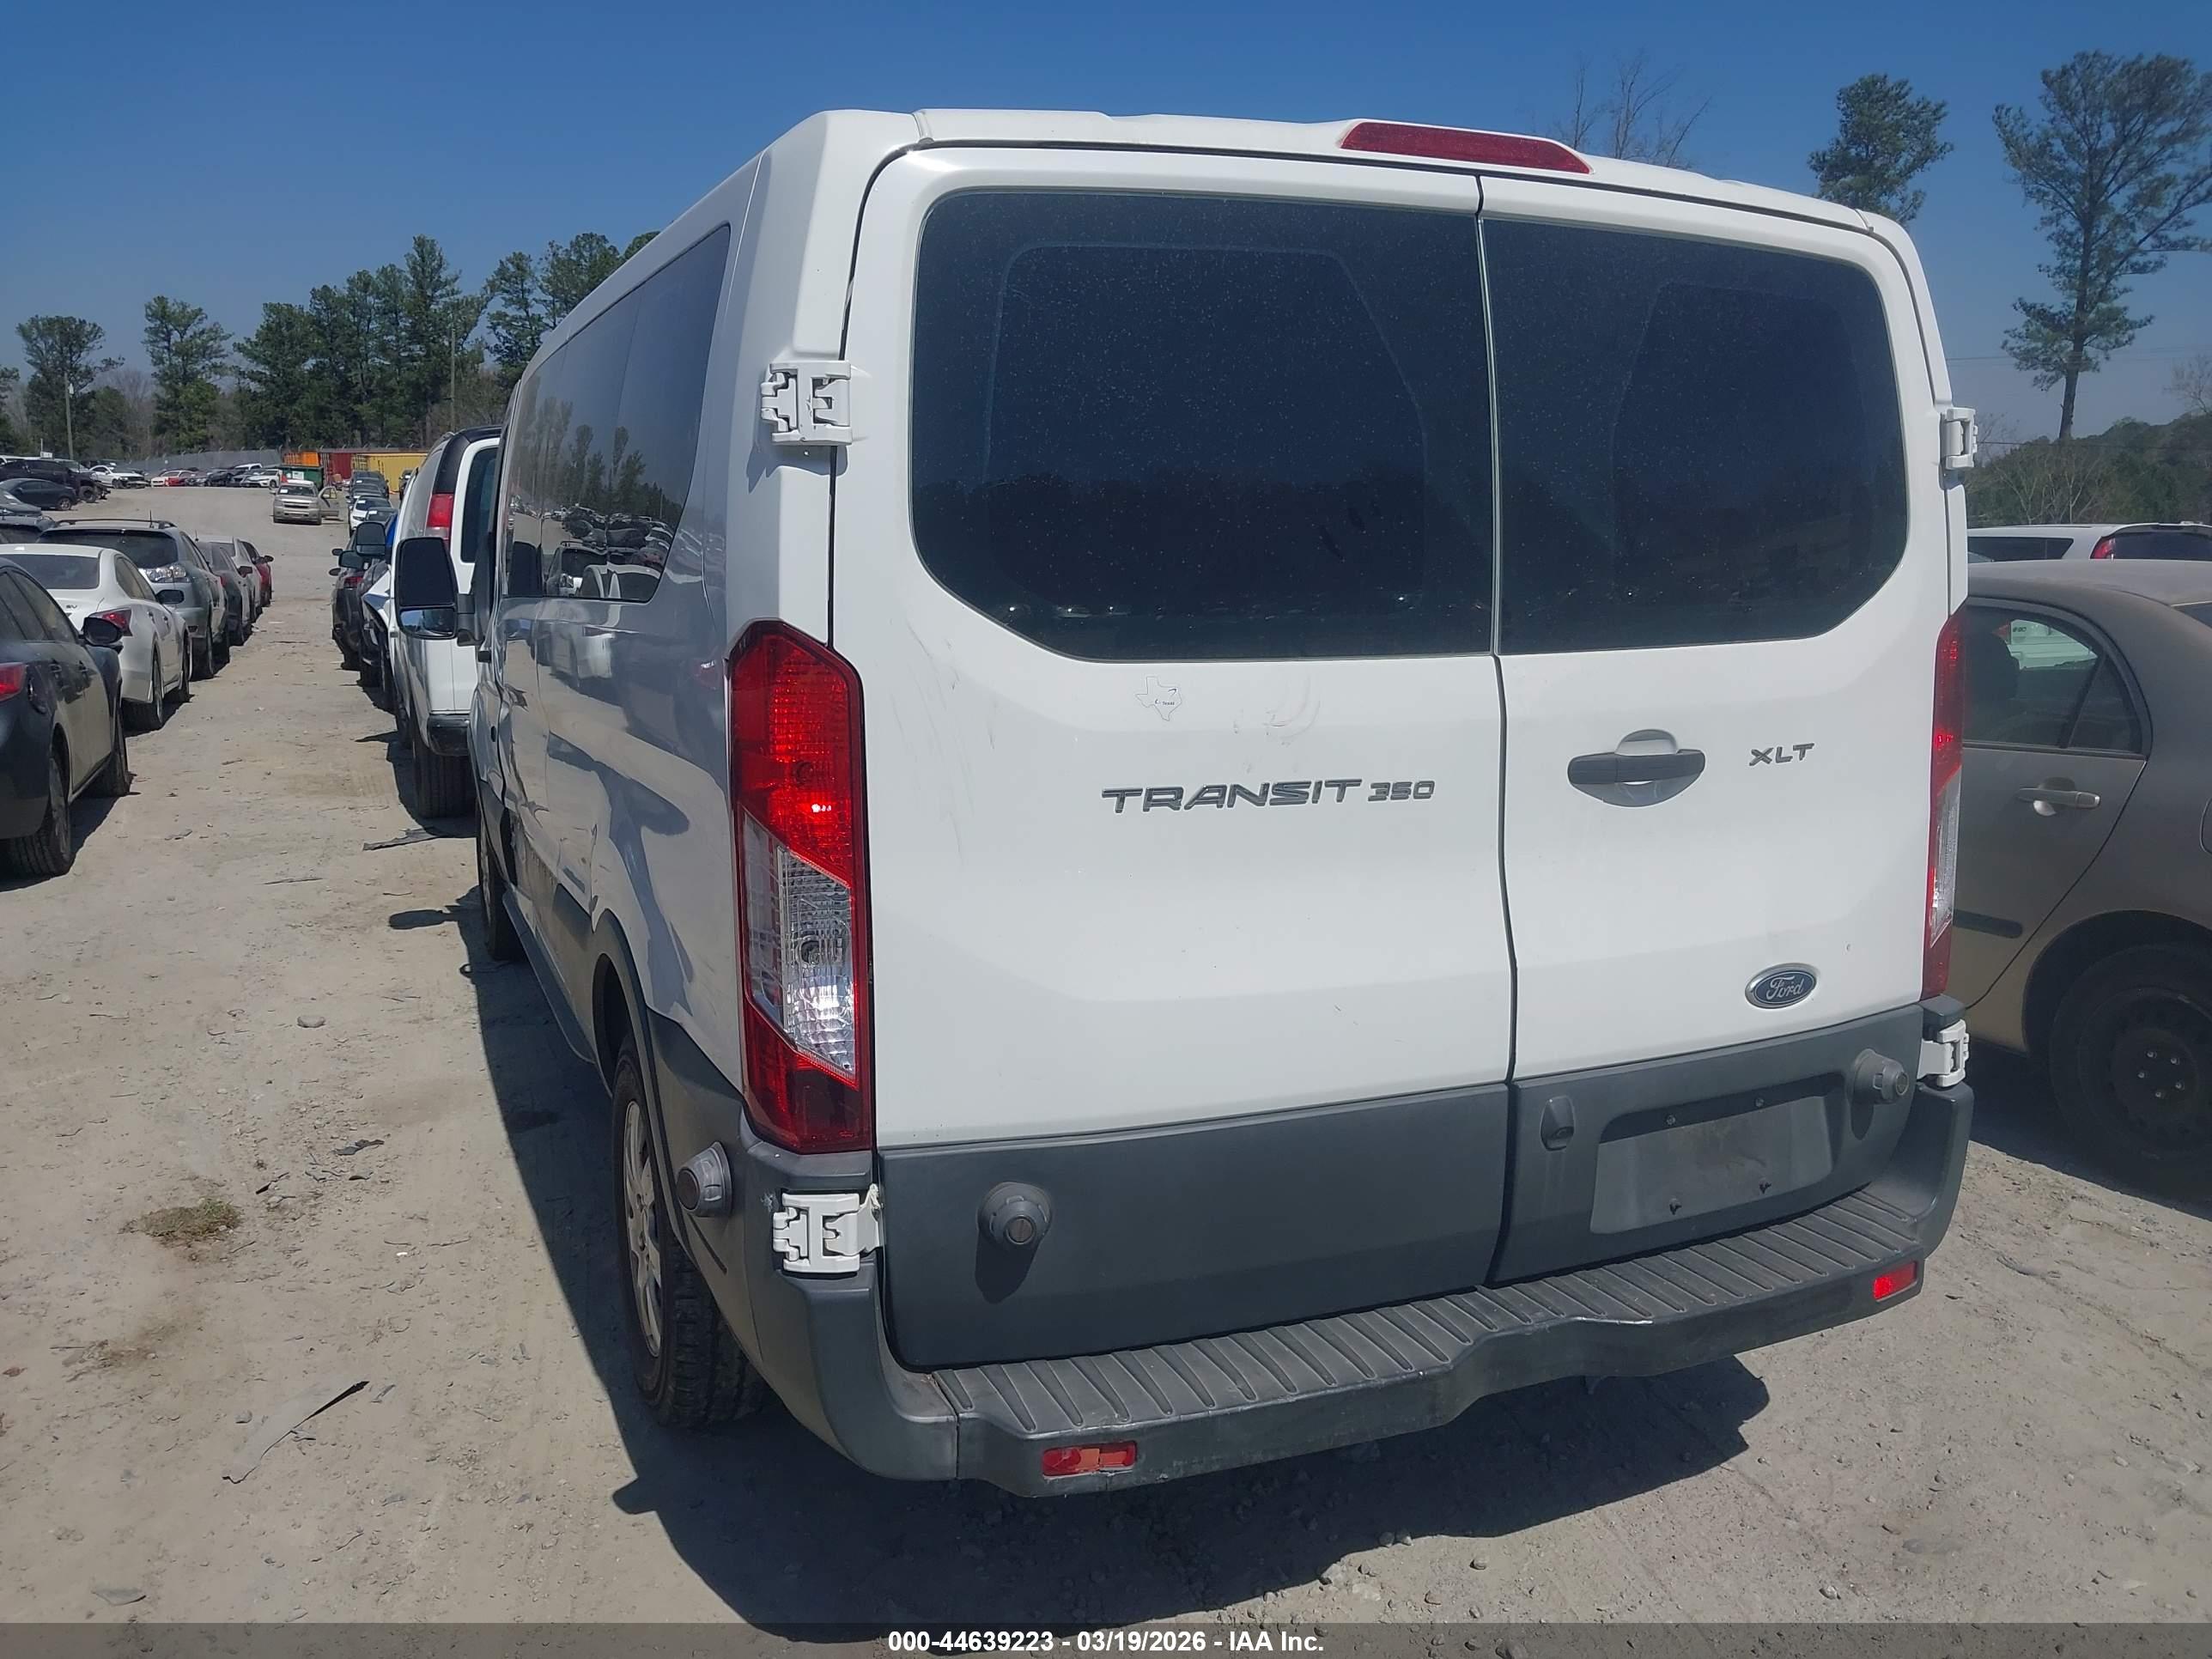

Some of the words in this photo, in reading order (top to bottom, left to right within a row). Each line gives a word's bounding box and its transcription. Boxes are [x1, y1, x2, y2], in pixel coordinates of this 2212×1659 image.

[1748, 743, 1814, 766] XLT
[1102, 779, 1363, 813] TRANSIT
[1368, 781, 1435, 802] 350
[1765, 975, 1804, 1000] Ford
